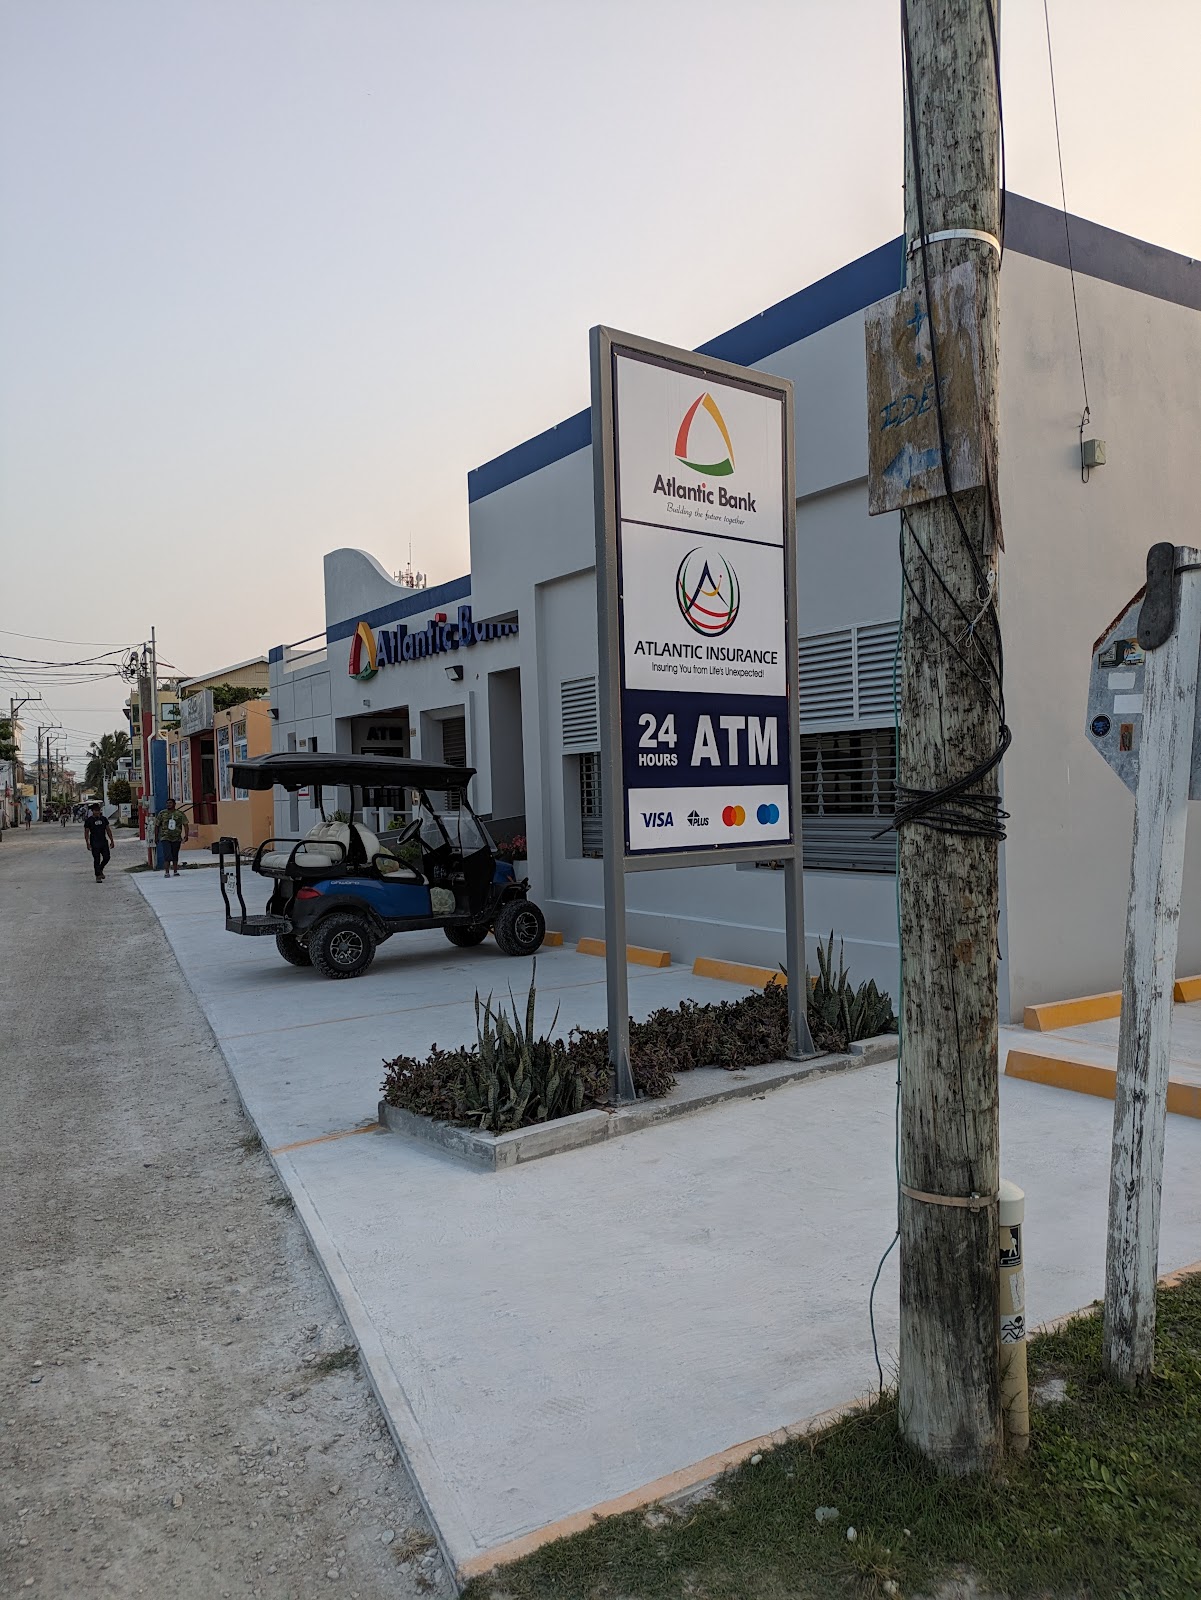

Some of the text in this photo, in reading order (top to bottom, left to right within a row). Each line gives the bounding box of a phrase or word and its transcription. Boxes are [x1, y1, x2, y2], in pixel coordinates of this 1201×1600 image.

[653, 474, 756, 513] Atlantic Bank
[666, 501, 745, 525] Building the future together
[375, 605, 518, 667] Atlantic Ban
[634, 640, 778, 665] ATLANTIC INSURANCE
[651, 662, 765, 678] Insuring You from Life's Unexpected!
[638, 713, 778, 766] 24 ATM
[638, 753, 678, 767] HOURS
[640, 811, 710, 828] VISA PLUS
